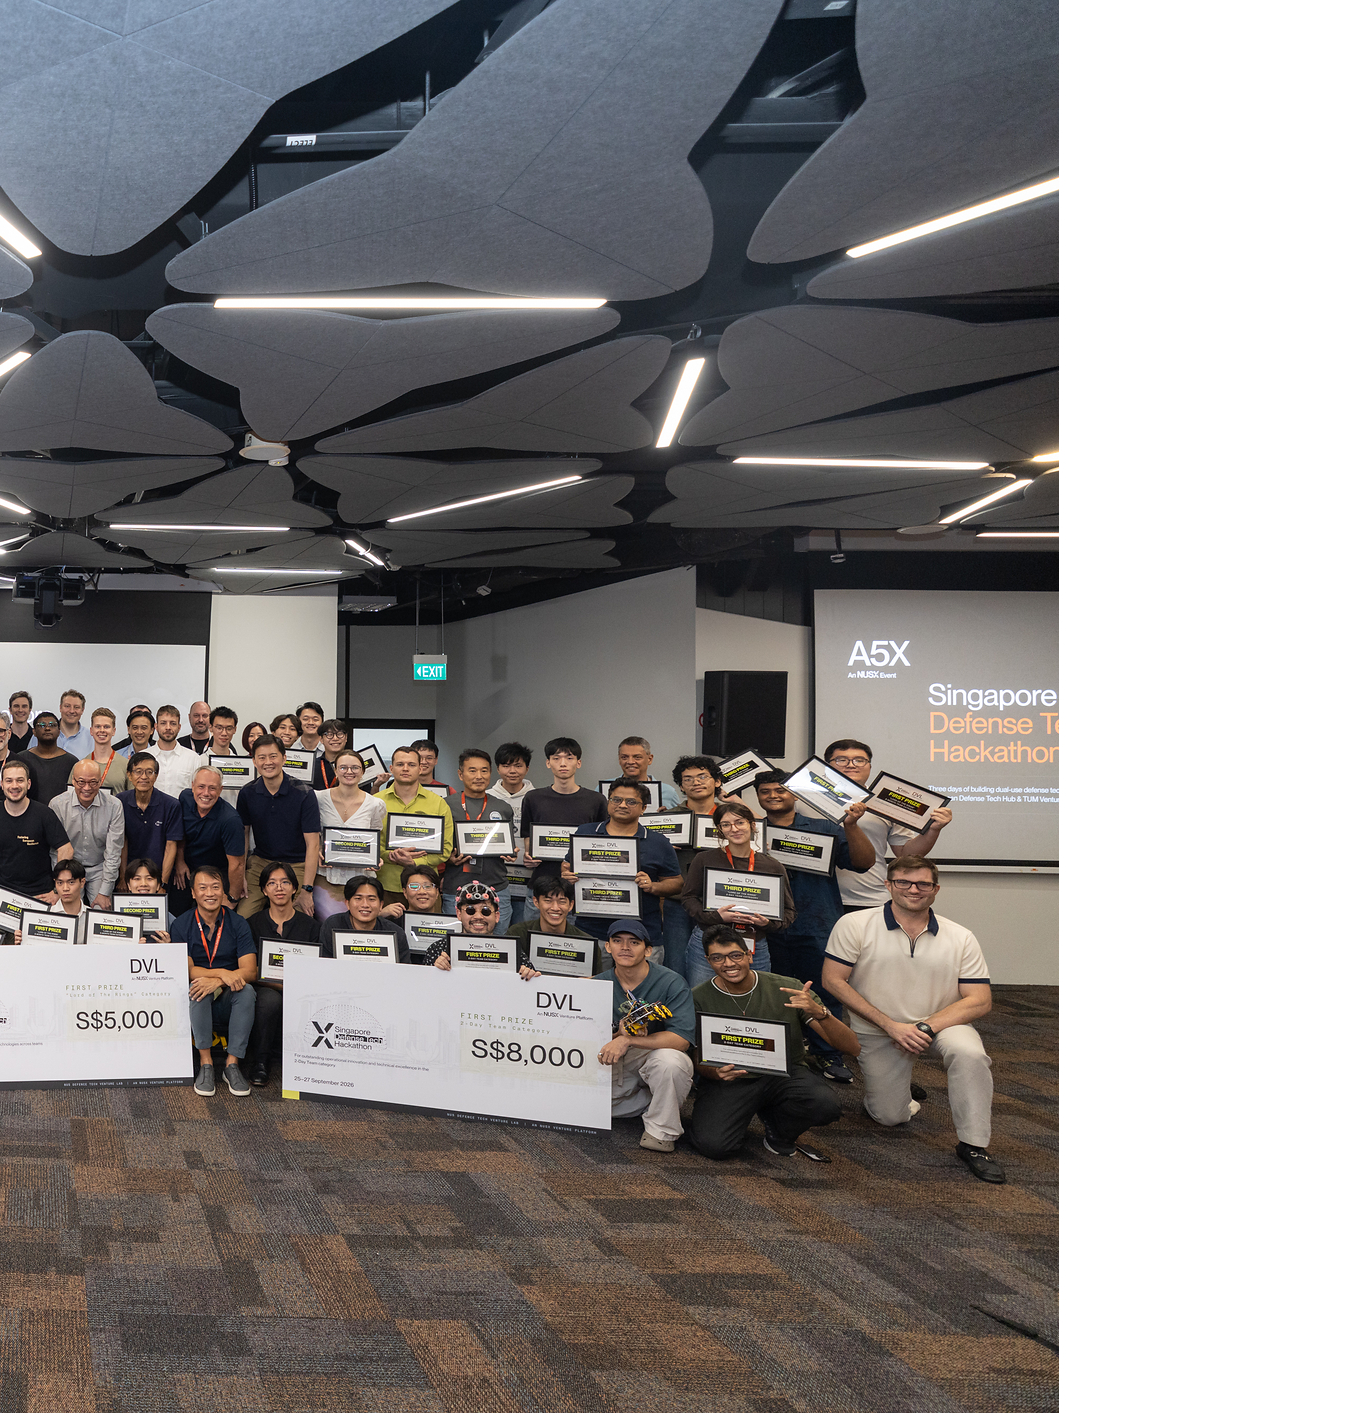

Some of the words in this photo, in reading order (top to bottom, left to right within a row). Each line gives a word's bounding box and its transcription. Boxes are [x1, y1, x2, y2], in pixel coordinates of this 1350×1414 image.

[848, 640, 911, 666] A5X
[422, 666, 443, 677] EXIT
[857, 671, 879, 679] NUSX
[928, 683, 1057, 710] Singapore
[930, 712, 1033, 734] Defense
[1040, 712, 1059, 734] T
[888, 791, 904, 800] FIRST
[904, 797, 921, 808] PRIZE
[779, 840, 797, 848] THIRD
[743, 886, 762, 894] PRIZE
[130, 959, 164, 973] DVL
[536, 992, 581, 1012] DVL
[76, 1010, 163, 1032] S$5,000
[501, 1016, 533, 1025] PRIZE
[335, 1026, 371, 1036] Singapore
[512, 1025, 550, 1034] Category
[721, 1034, 742, 1043] FIRST
[742, 1036, 764, 1045] PRIZE
[335, 1041, 372, 1050] Hackathon
[471, 1039, 584, 1069] S$8,000
[311, 1078, 339, 1086] September
